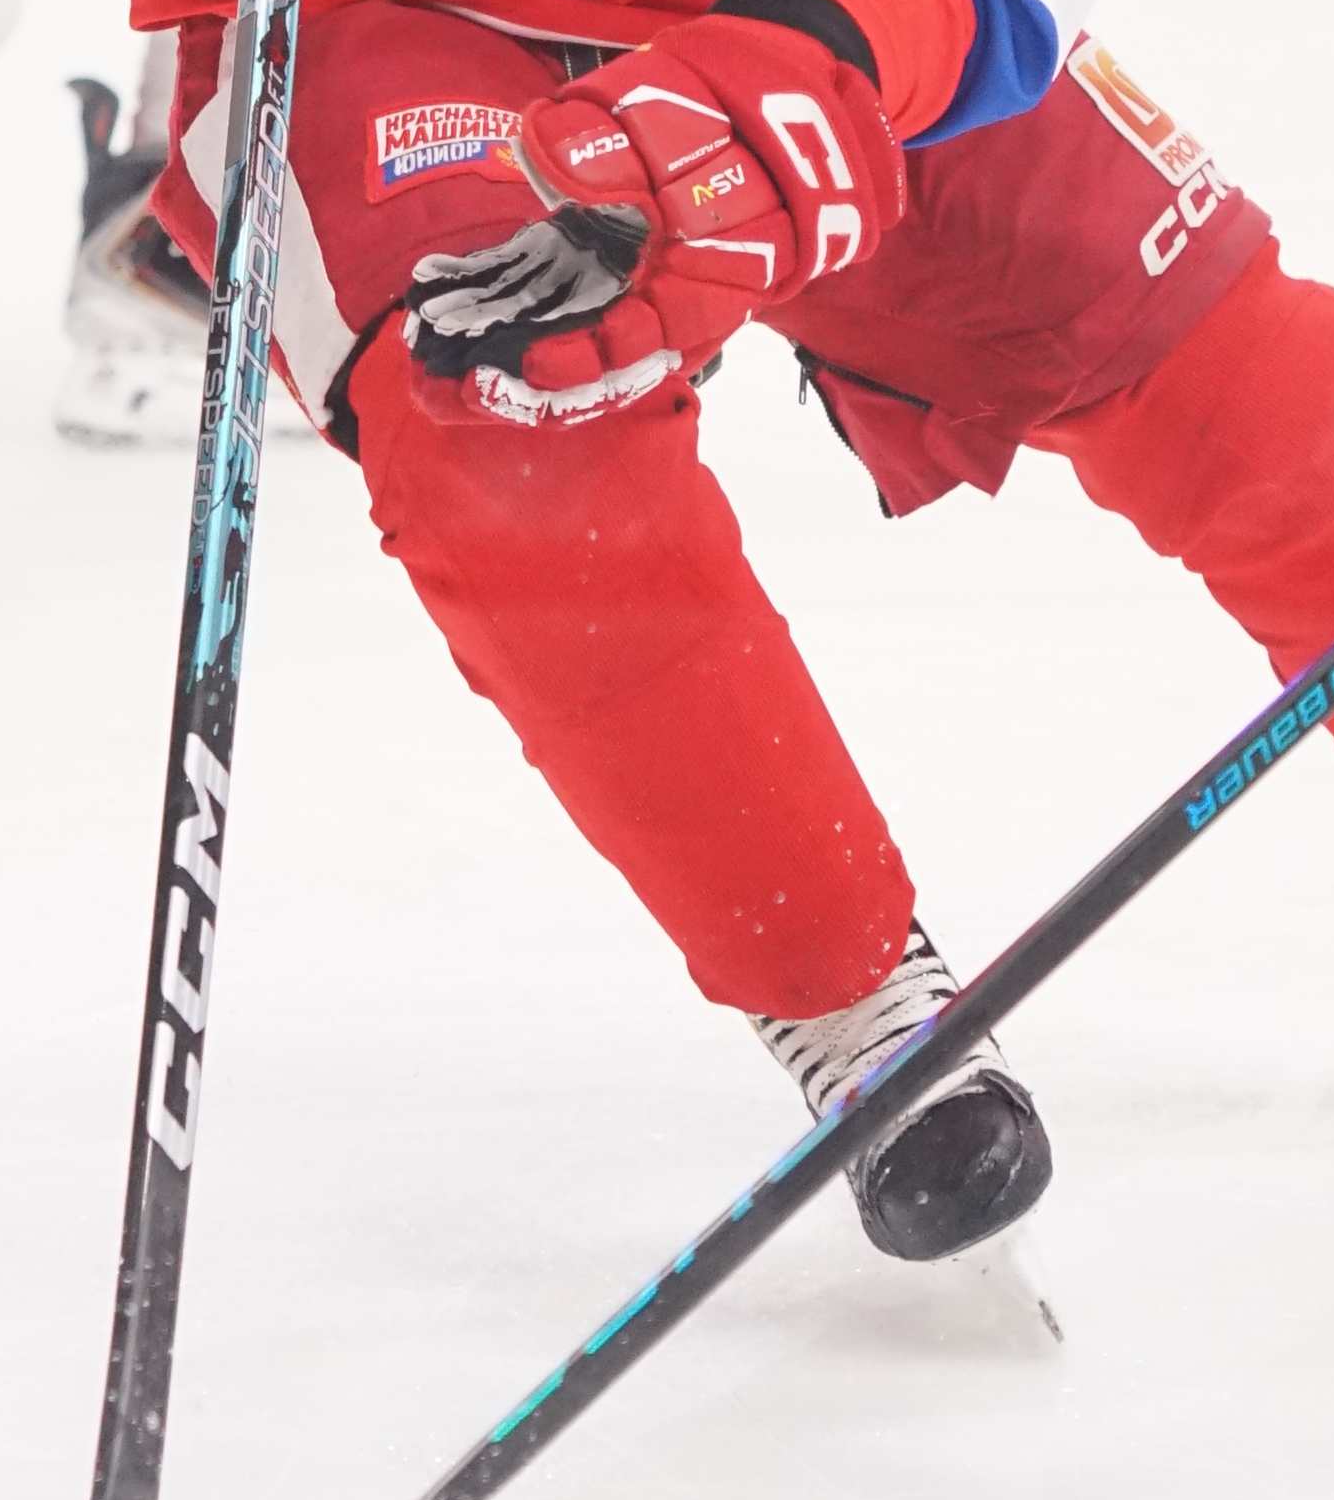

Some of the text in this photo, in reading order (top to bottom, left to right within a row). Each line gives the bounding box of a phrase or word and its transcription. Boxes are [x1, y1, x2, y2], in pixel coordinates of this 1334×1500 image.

[394, 141, 484, 177] ЮНИОР
[569, 132, 630, 167] CCM
[232, 102, 289, 488] JETSPEED
[191, 275, 233, 527] JETSPEED
[1184, 682, 1329, 832] BAUER
[146, 731, 231, 1171] CCM
